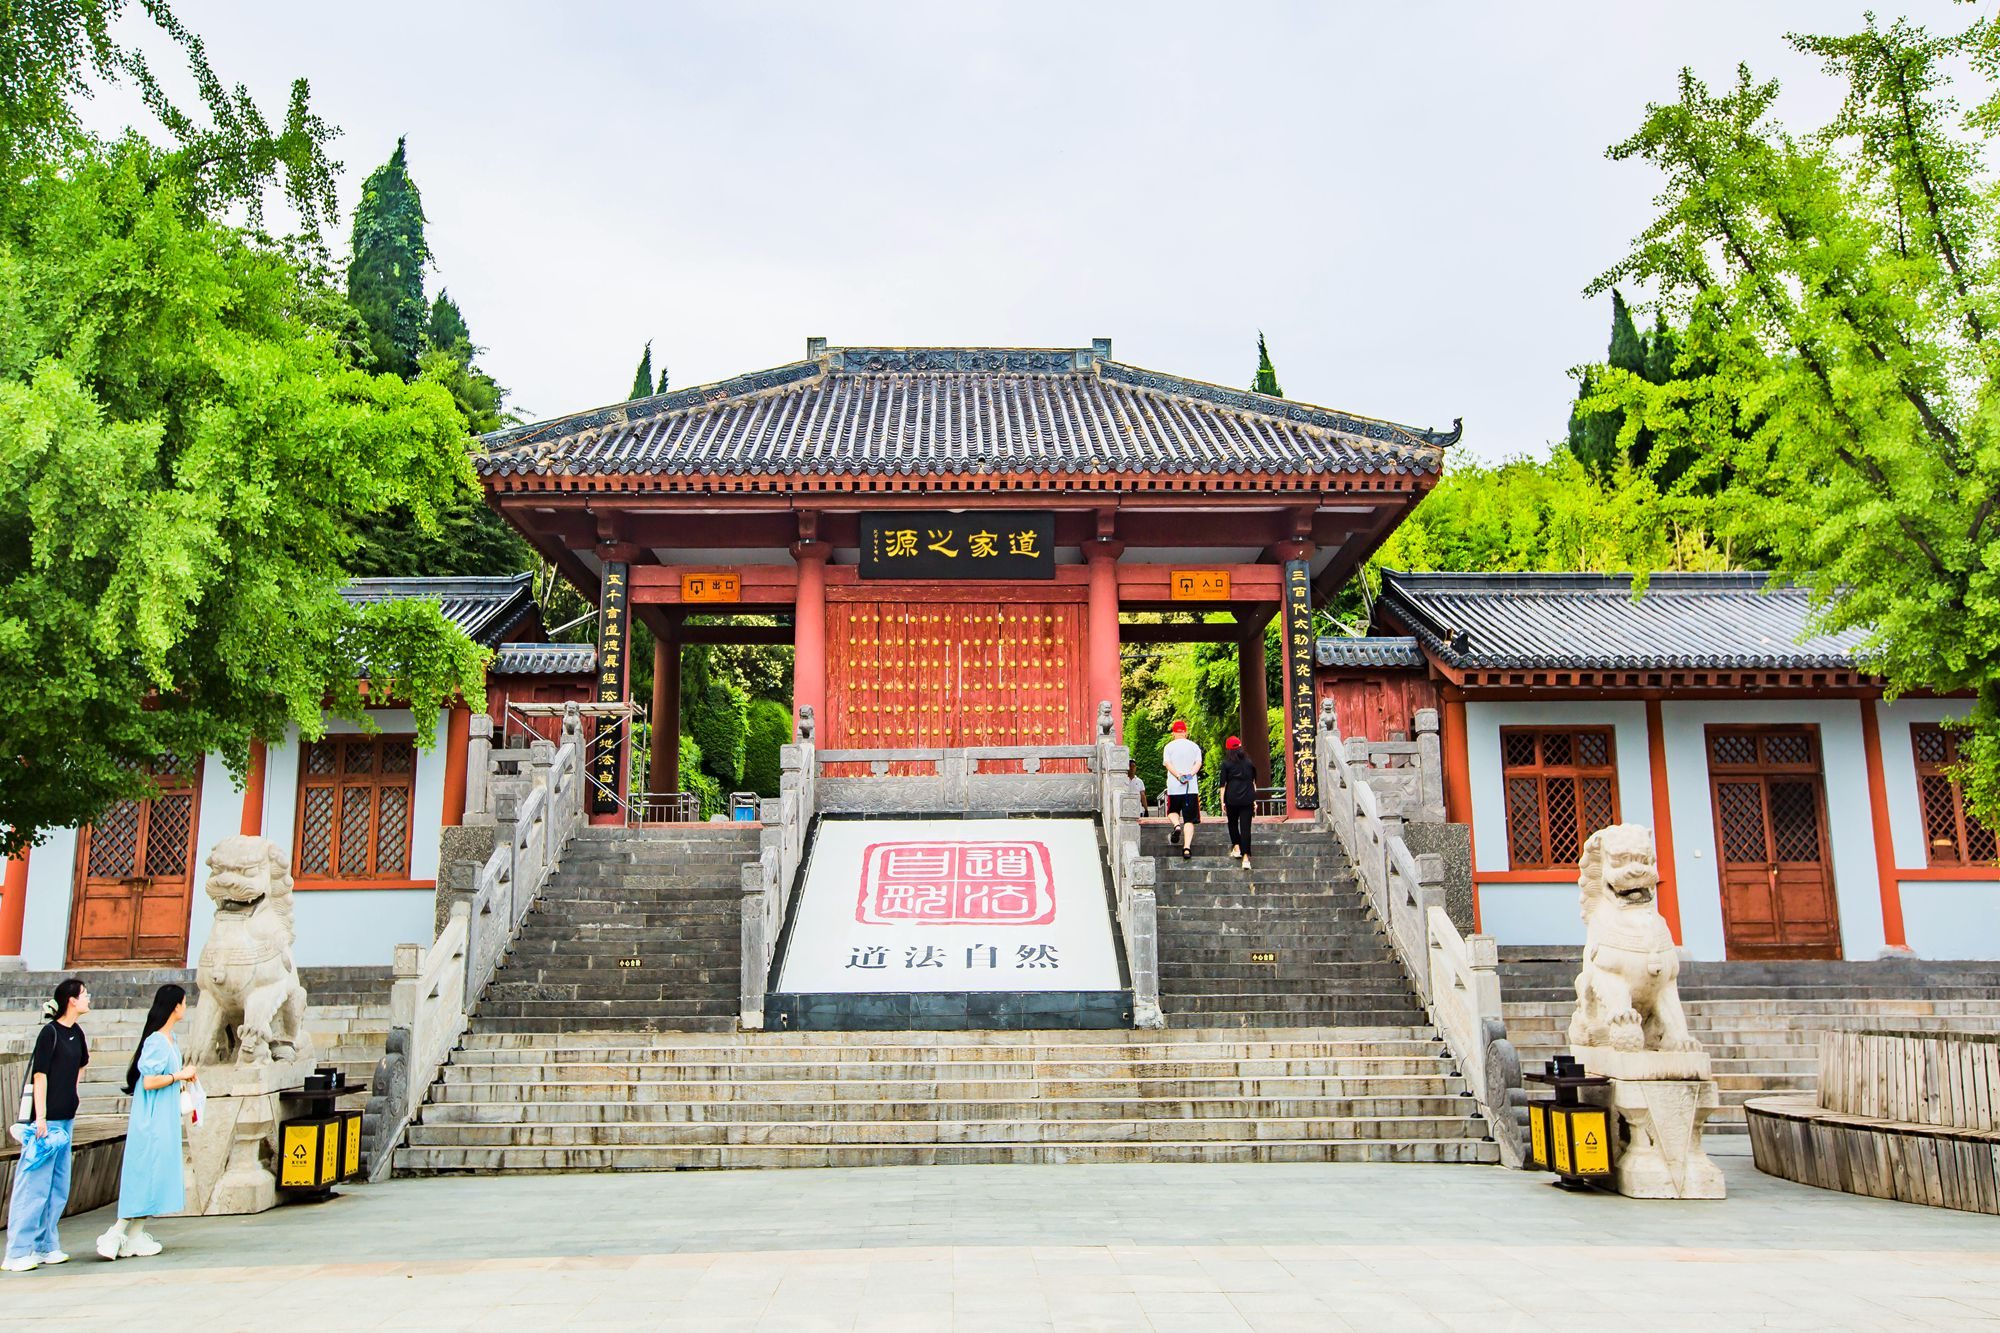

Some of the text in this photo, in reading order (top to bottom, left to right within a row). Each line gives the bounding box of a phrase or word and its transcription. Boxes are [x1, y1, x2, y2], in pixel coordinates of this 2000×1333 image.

[884, 529, 1041, 559] 道家之源
[712, 580, 734, 590] 出口
[1202, 579, 1224, 588] 入口
[844, 943, 1060, 969] 道法自然
